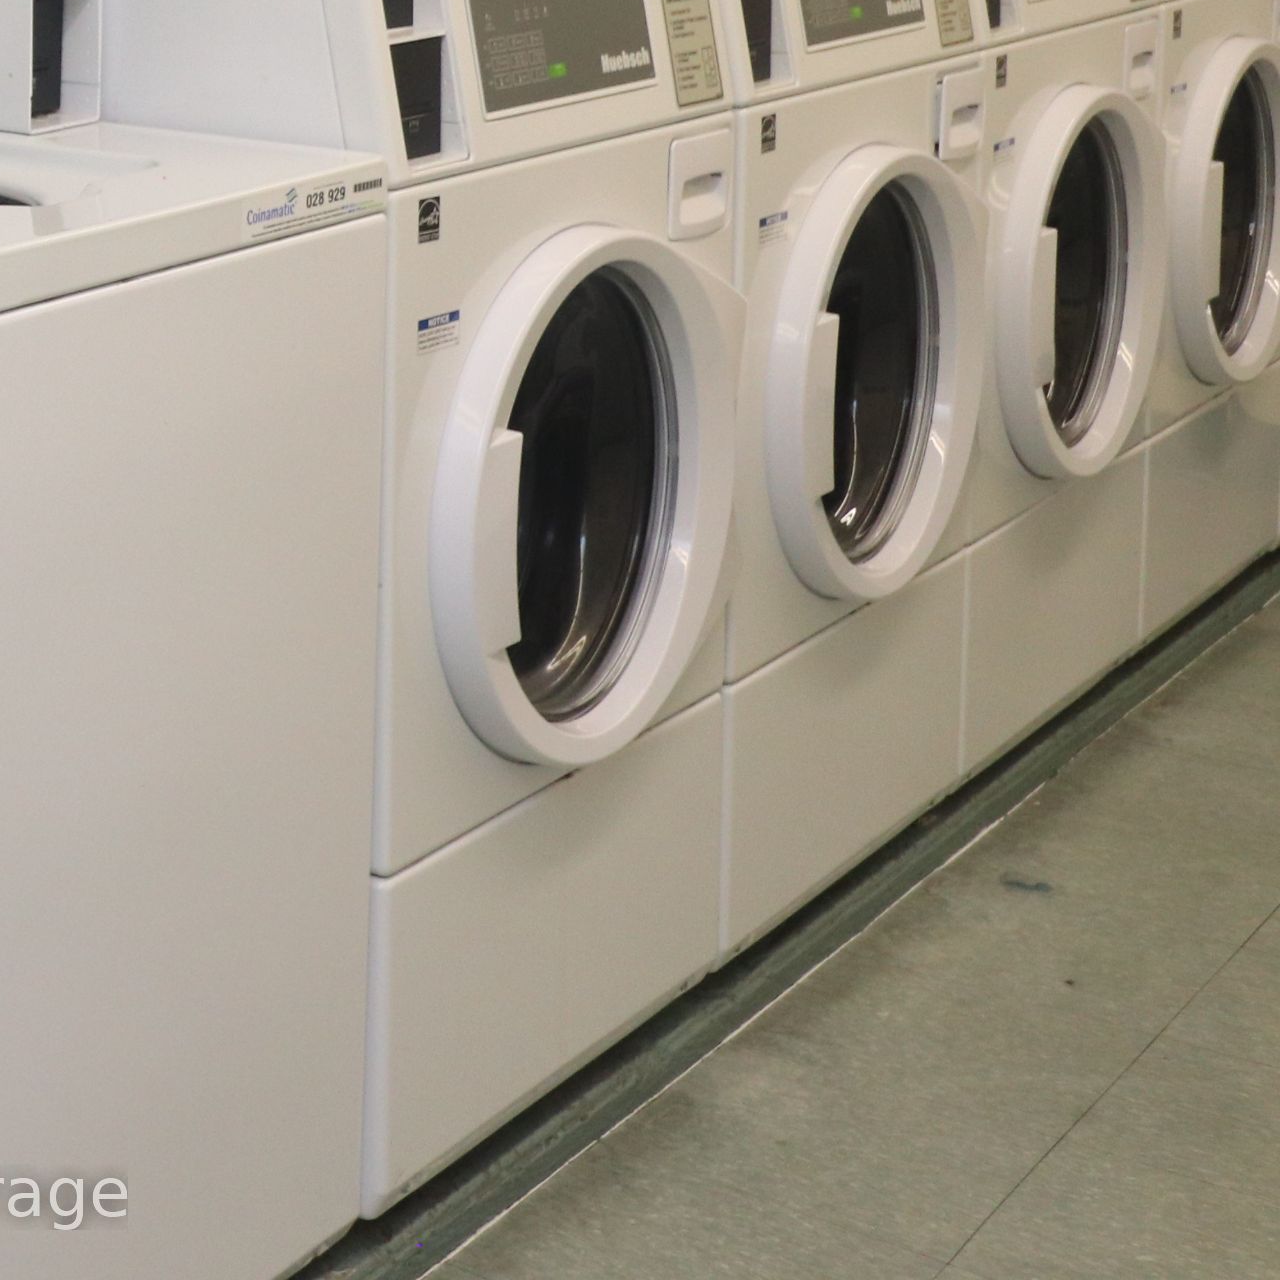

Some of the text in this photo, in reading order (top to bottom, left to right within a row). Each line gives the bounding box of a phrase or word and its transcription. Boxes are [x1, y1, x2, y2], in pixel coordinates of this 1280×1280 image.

[601, 47, 650, 73] Huebsch
[247, 201, 295, 225] Coinamatic
[306, 191, 324, 208] 028
[328, 186, 346, 203] 929
